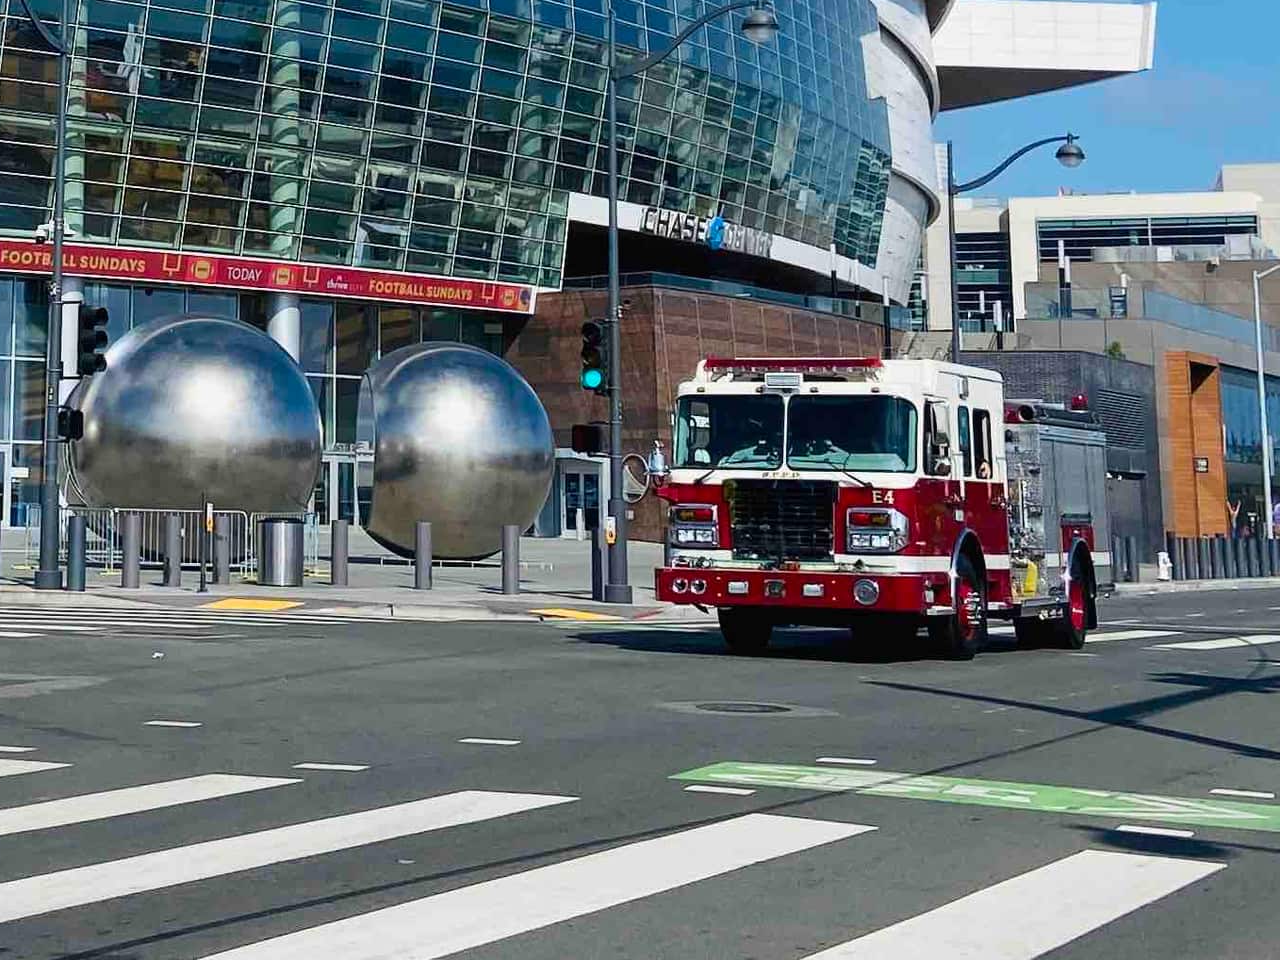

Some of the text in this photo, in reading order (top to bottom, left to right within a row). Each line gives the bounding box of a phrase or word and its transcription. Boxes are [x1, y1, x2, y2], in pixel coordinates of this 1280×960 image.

[642, 208, 709, 245] CHASE
[79, 254, 146, 273] SUNDAYS
[227, 266, 263, 282] TODAY
[370, 279, 424, 297] FOOTBALL
[426, 285, 473, 302] SUNDAYS
[871, 489, 896, 505] E4
